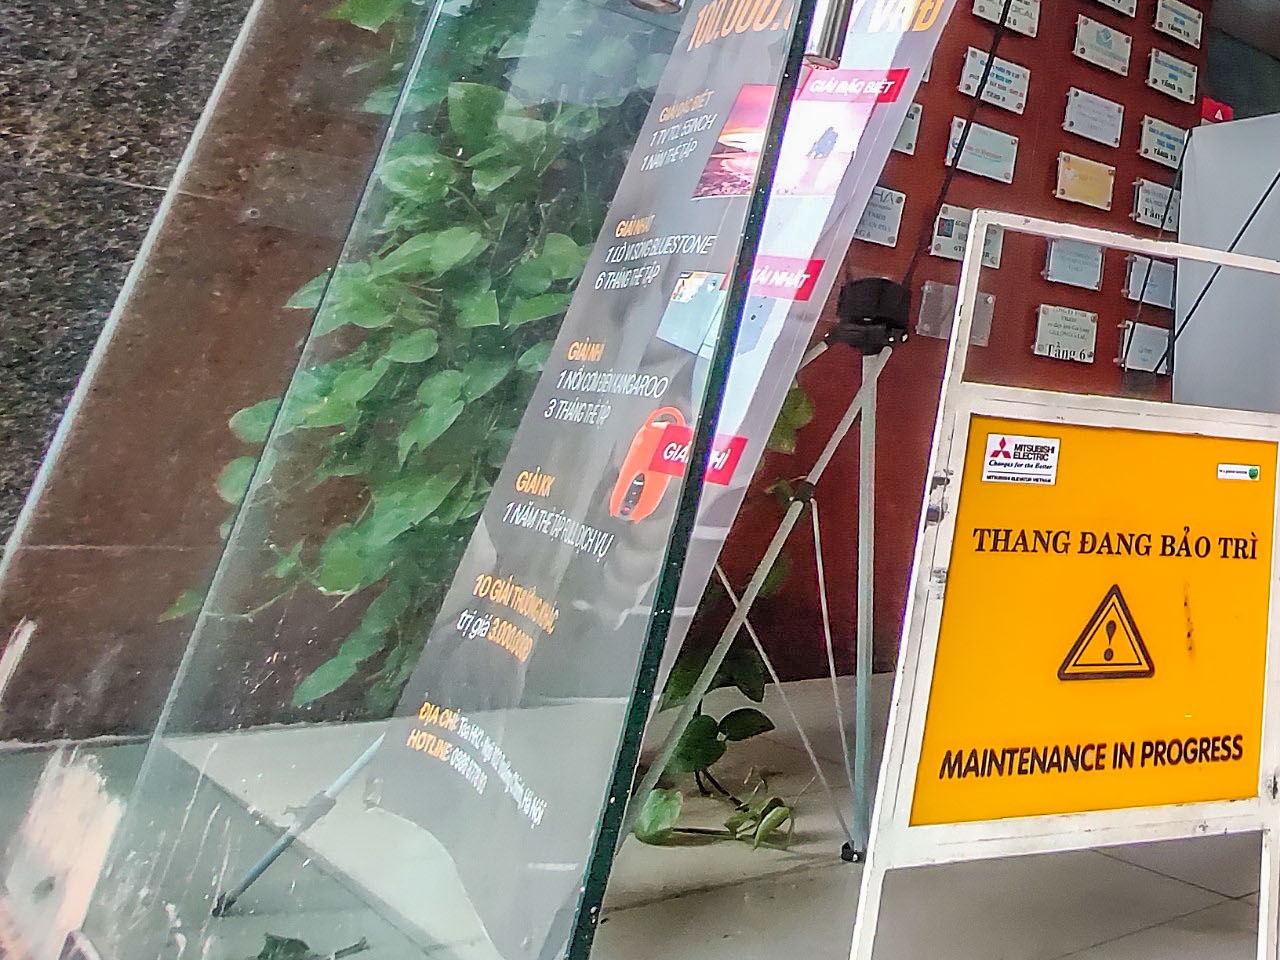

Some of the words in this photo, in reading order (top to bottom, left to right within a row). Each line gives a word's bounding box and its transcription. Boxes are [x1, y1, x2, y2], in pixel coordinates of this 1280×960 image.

[594, 271, 606, 290] 6
[1079, 348, 1086, 361] 6
[544, 398, 557, 418] 3
[1013, 452, 1049, 462] ELECTRIC
[1014, 443, 1055, 454] MITSUBISHI
[502, 502, 516, 523] 1
[972, 528, 1071, 555] THANG
[1077, 531, 1152, 558] ĐANG
[1159, 526, 1212, 559] BẢO
[1218, 531, 1259, 561] TRÌ
[473, 574, 493, 599] 10
[418, 701, 440, 726] ĐỊA
[939, 743, 1106, 780] MAINTENANCE
[1112, 740, 1134, 770] IN
[1140, 734, 1244, 766] PROGRESS
